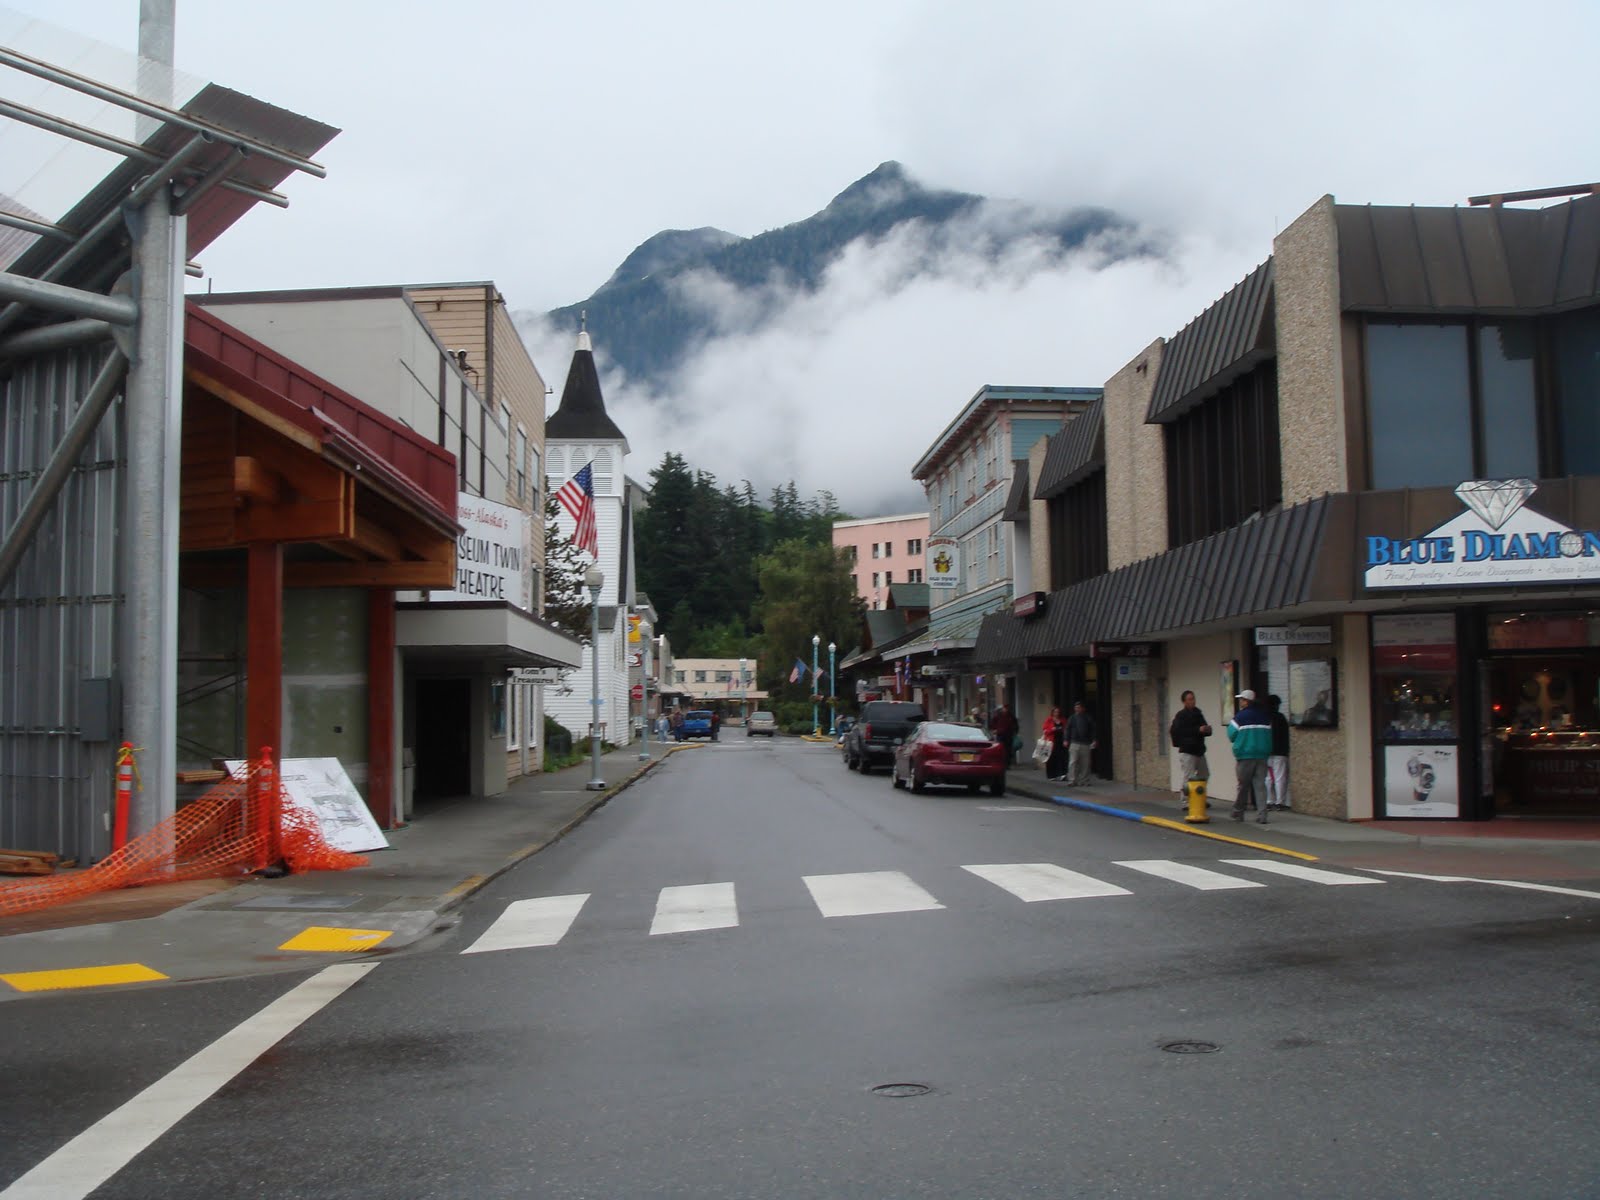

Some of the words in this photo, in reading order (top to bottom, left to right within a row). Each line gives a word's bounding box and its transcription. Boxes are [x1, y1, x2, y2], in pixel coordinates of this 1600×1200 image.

[457, 534, 490, 565] SEUM
[493, 542, 521, 572] TWIN
[1366, 535, 1455, 566] BLUE
[457, 568, 505, 600] HEATRE
[1406, 567, 1444, 583] Jewelry
